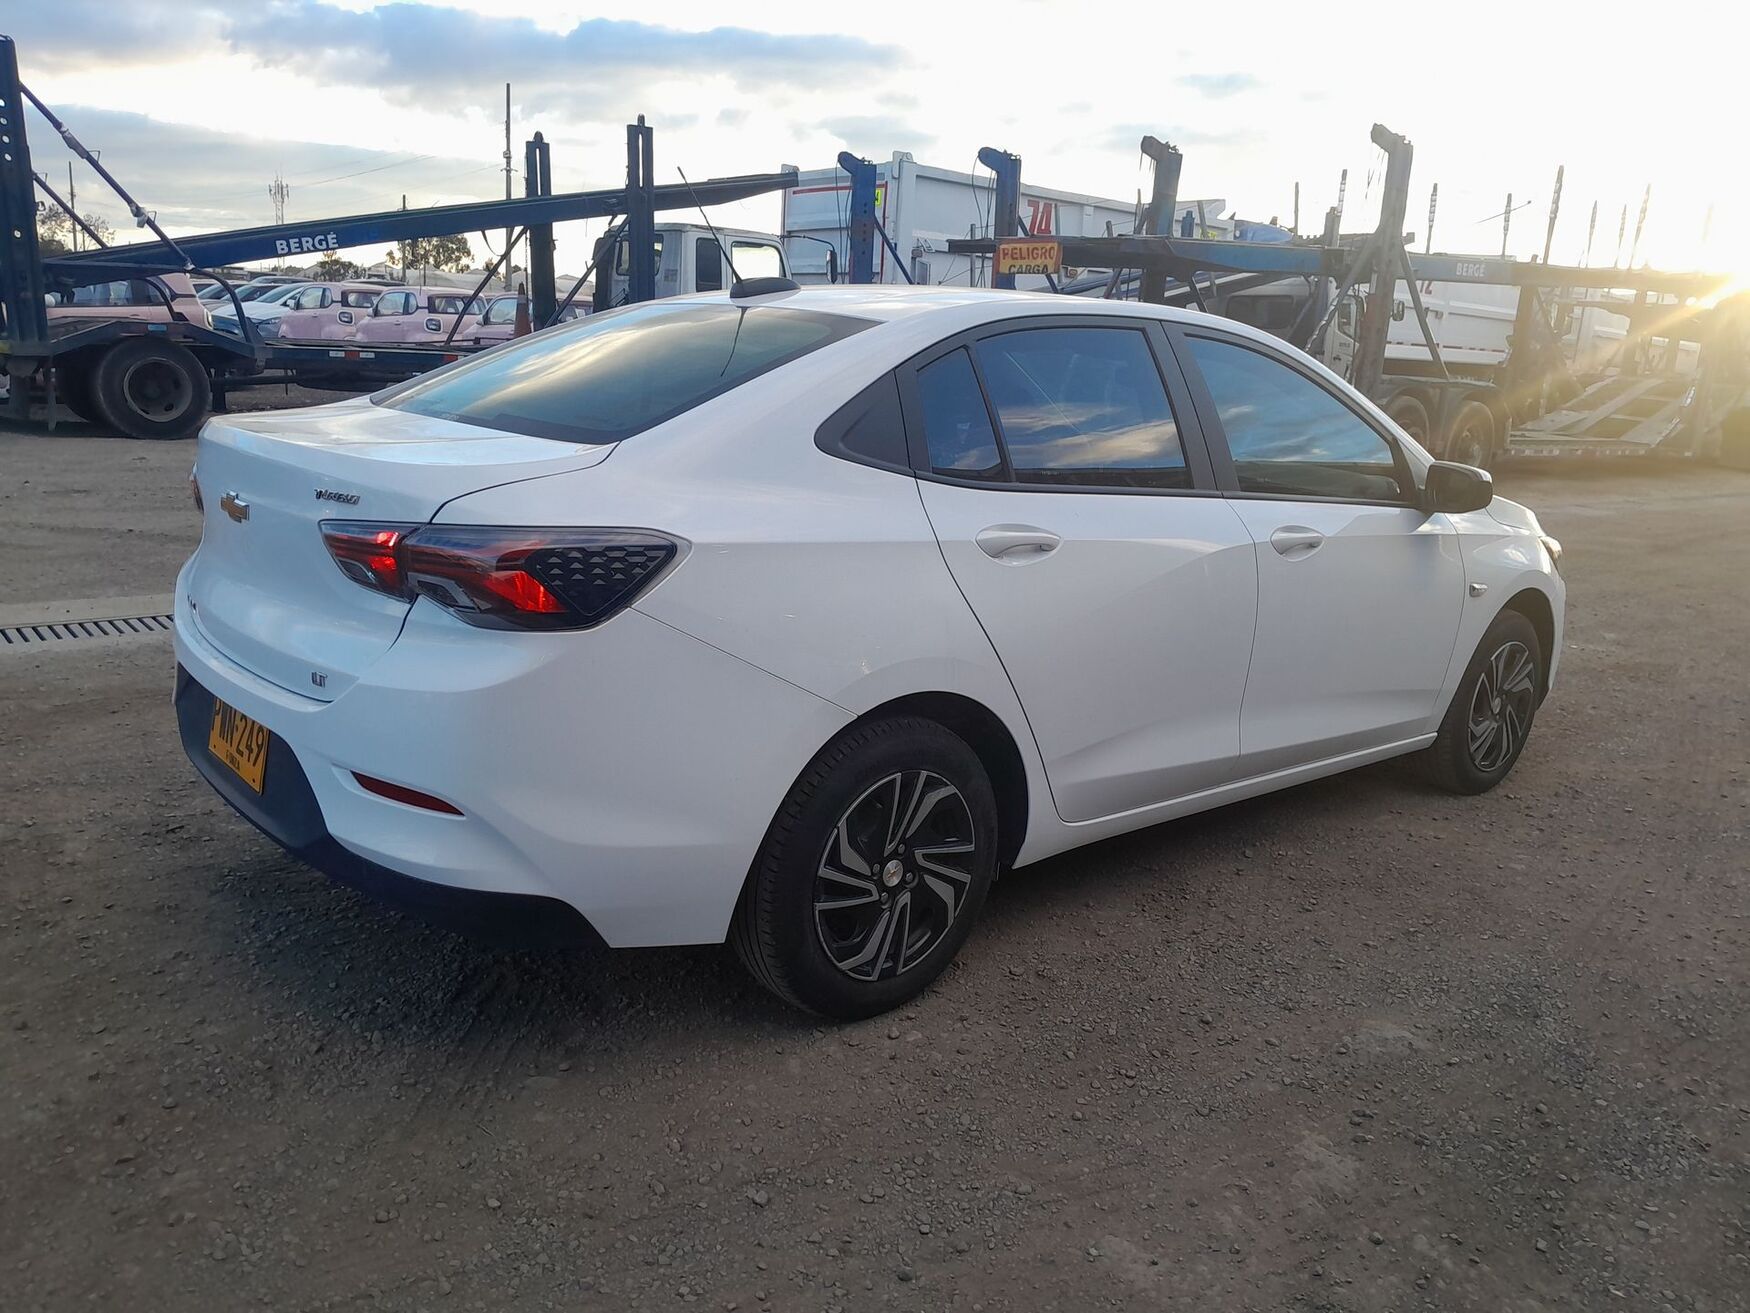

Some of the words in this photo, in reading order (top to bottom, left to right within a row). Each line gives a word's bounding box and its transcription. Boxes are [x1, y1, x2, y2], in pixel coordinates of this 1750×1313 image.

[1027, 199, 1053, 235] 74
[275, 232, 339, 254] BERGÉ
[1001, 246, 1056, 260] PELIGRO
[1008, 264, 1049, 274] CARGA
[311, 671, 328, 688] LT
